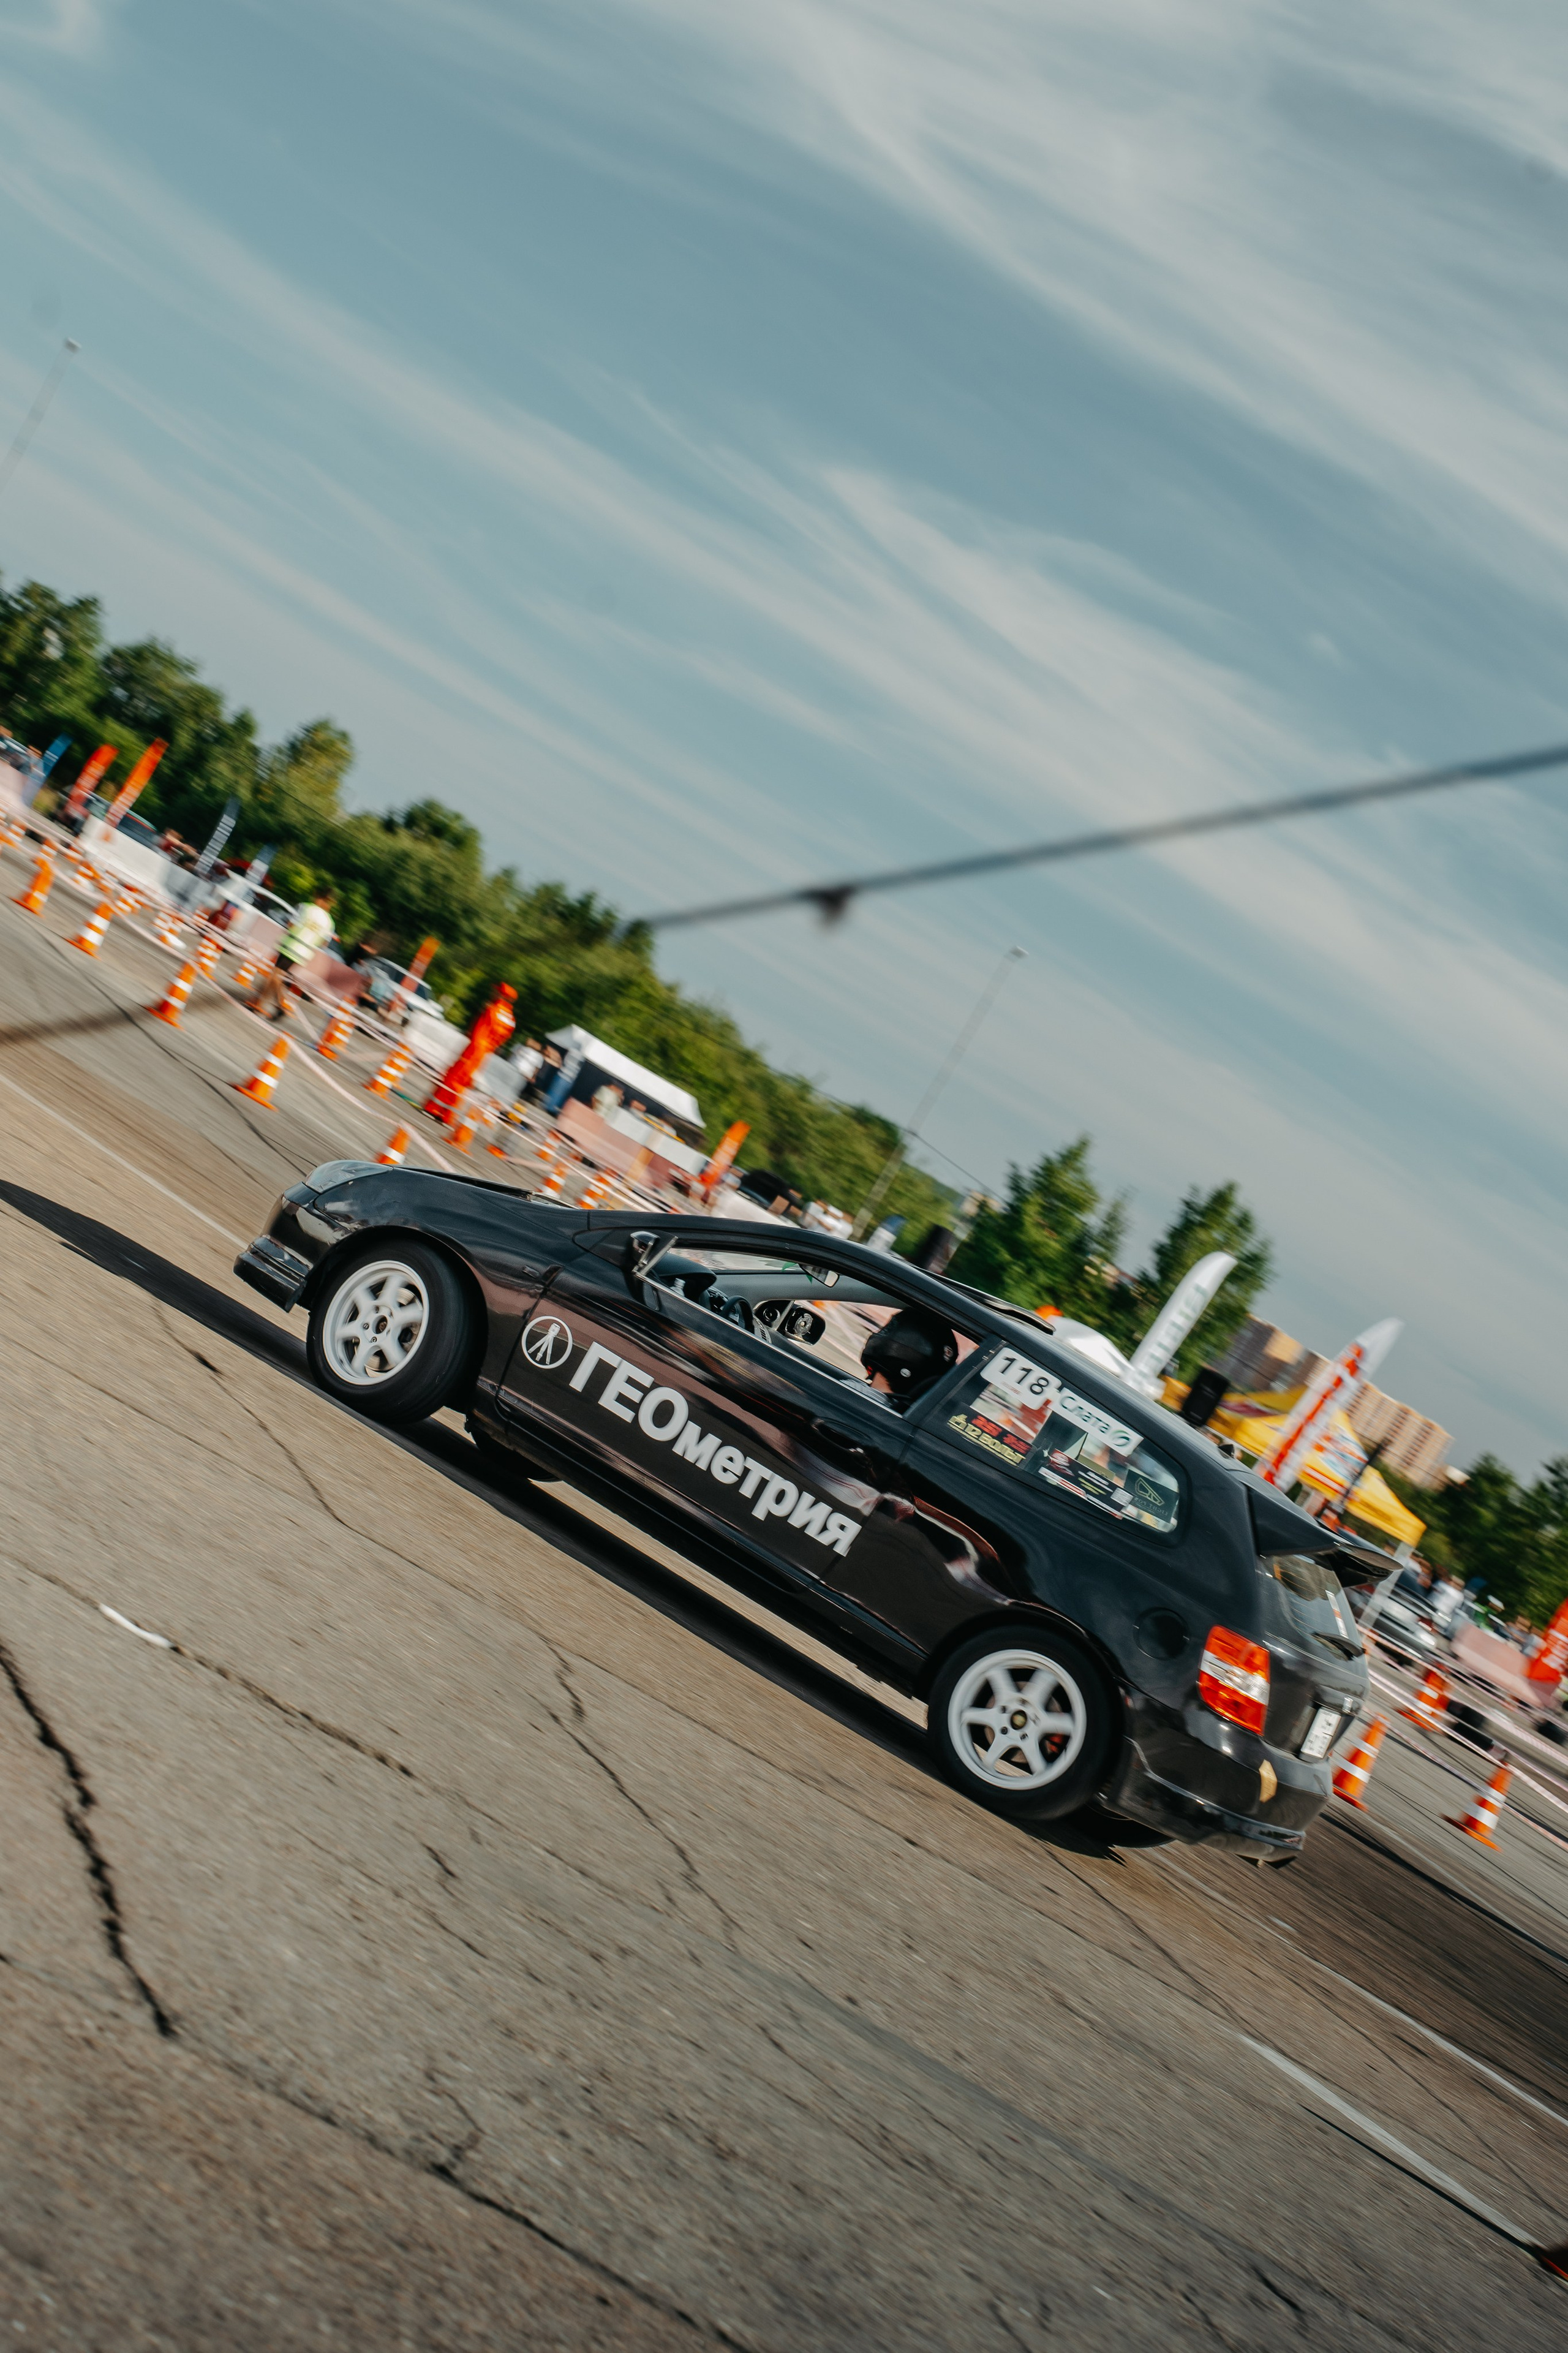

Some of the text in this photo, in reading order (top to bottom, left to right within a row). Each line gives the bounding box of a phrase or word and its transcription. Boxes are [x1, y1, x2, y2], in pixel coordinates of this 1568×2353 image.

[998, 1356, 1050, 1396] 118
[1060, 1396, 1111, 1434] Слата
[569, 1341, 862, 1557] ГЕОметрия
